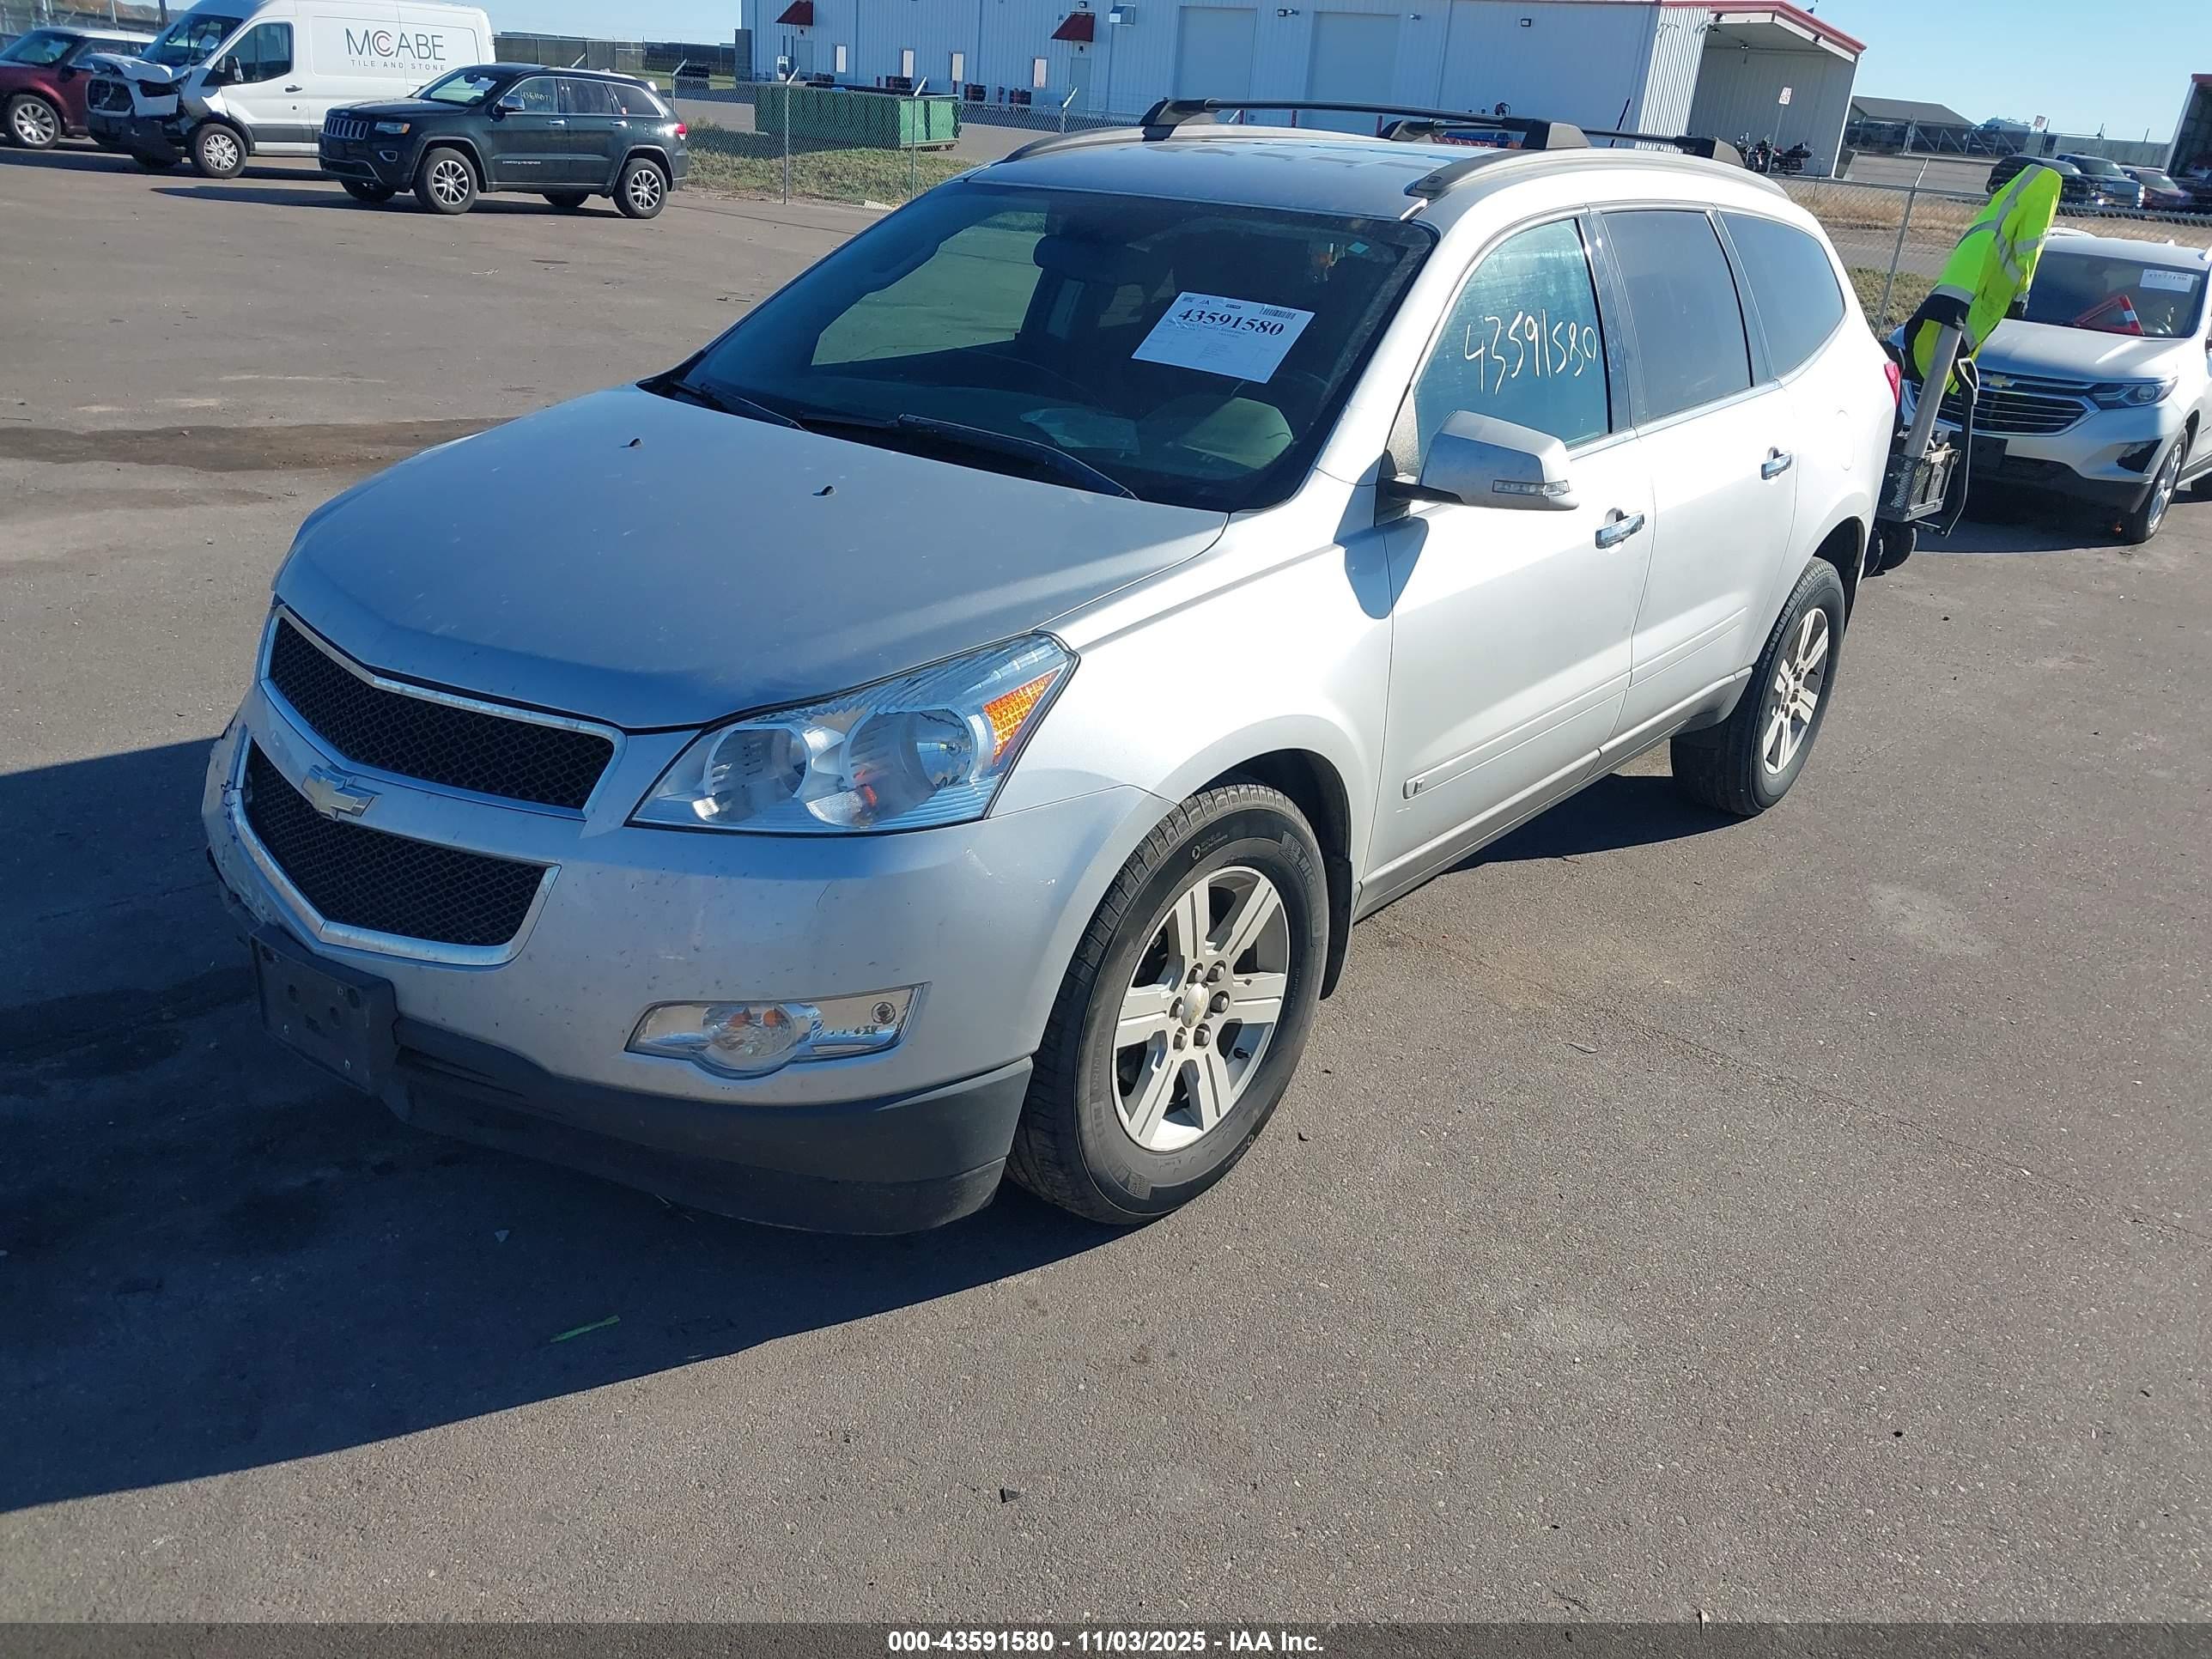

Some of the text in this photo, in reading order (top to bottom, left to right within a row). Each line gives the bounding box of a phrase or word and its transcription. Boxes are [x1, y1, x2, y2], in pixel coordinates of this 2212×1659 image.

[410, 63, 446, 71] STONE
[1177, 308, 1285, 337] 43591580
[1464, 308, 1597, 396] 43591580
